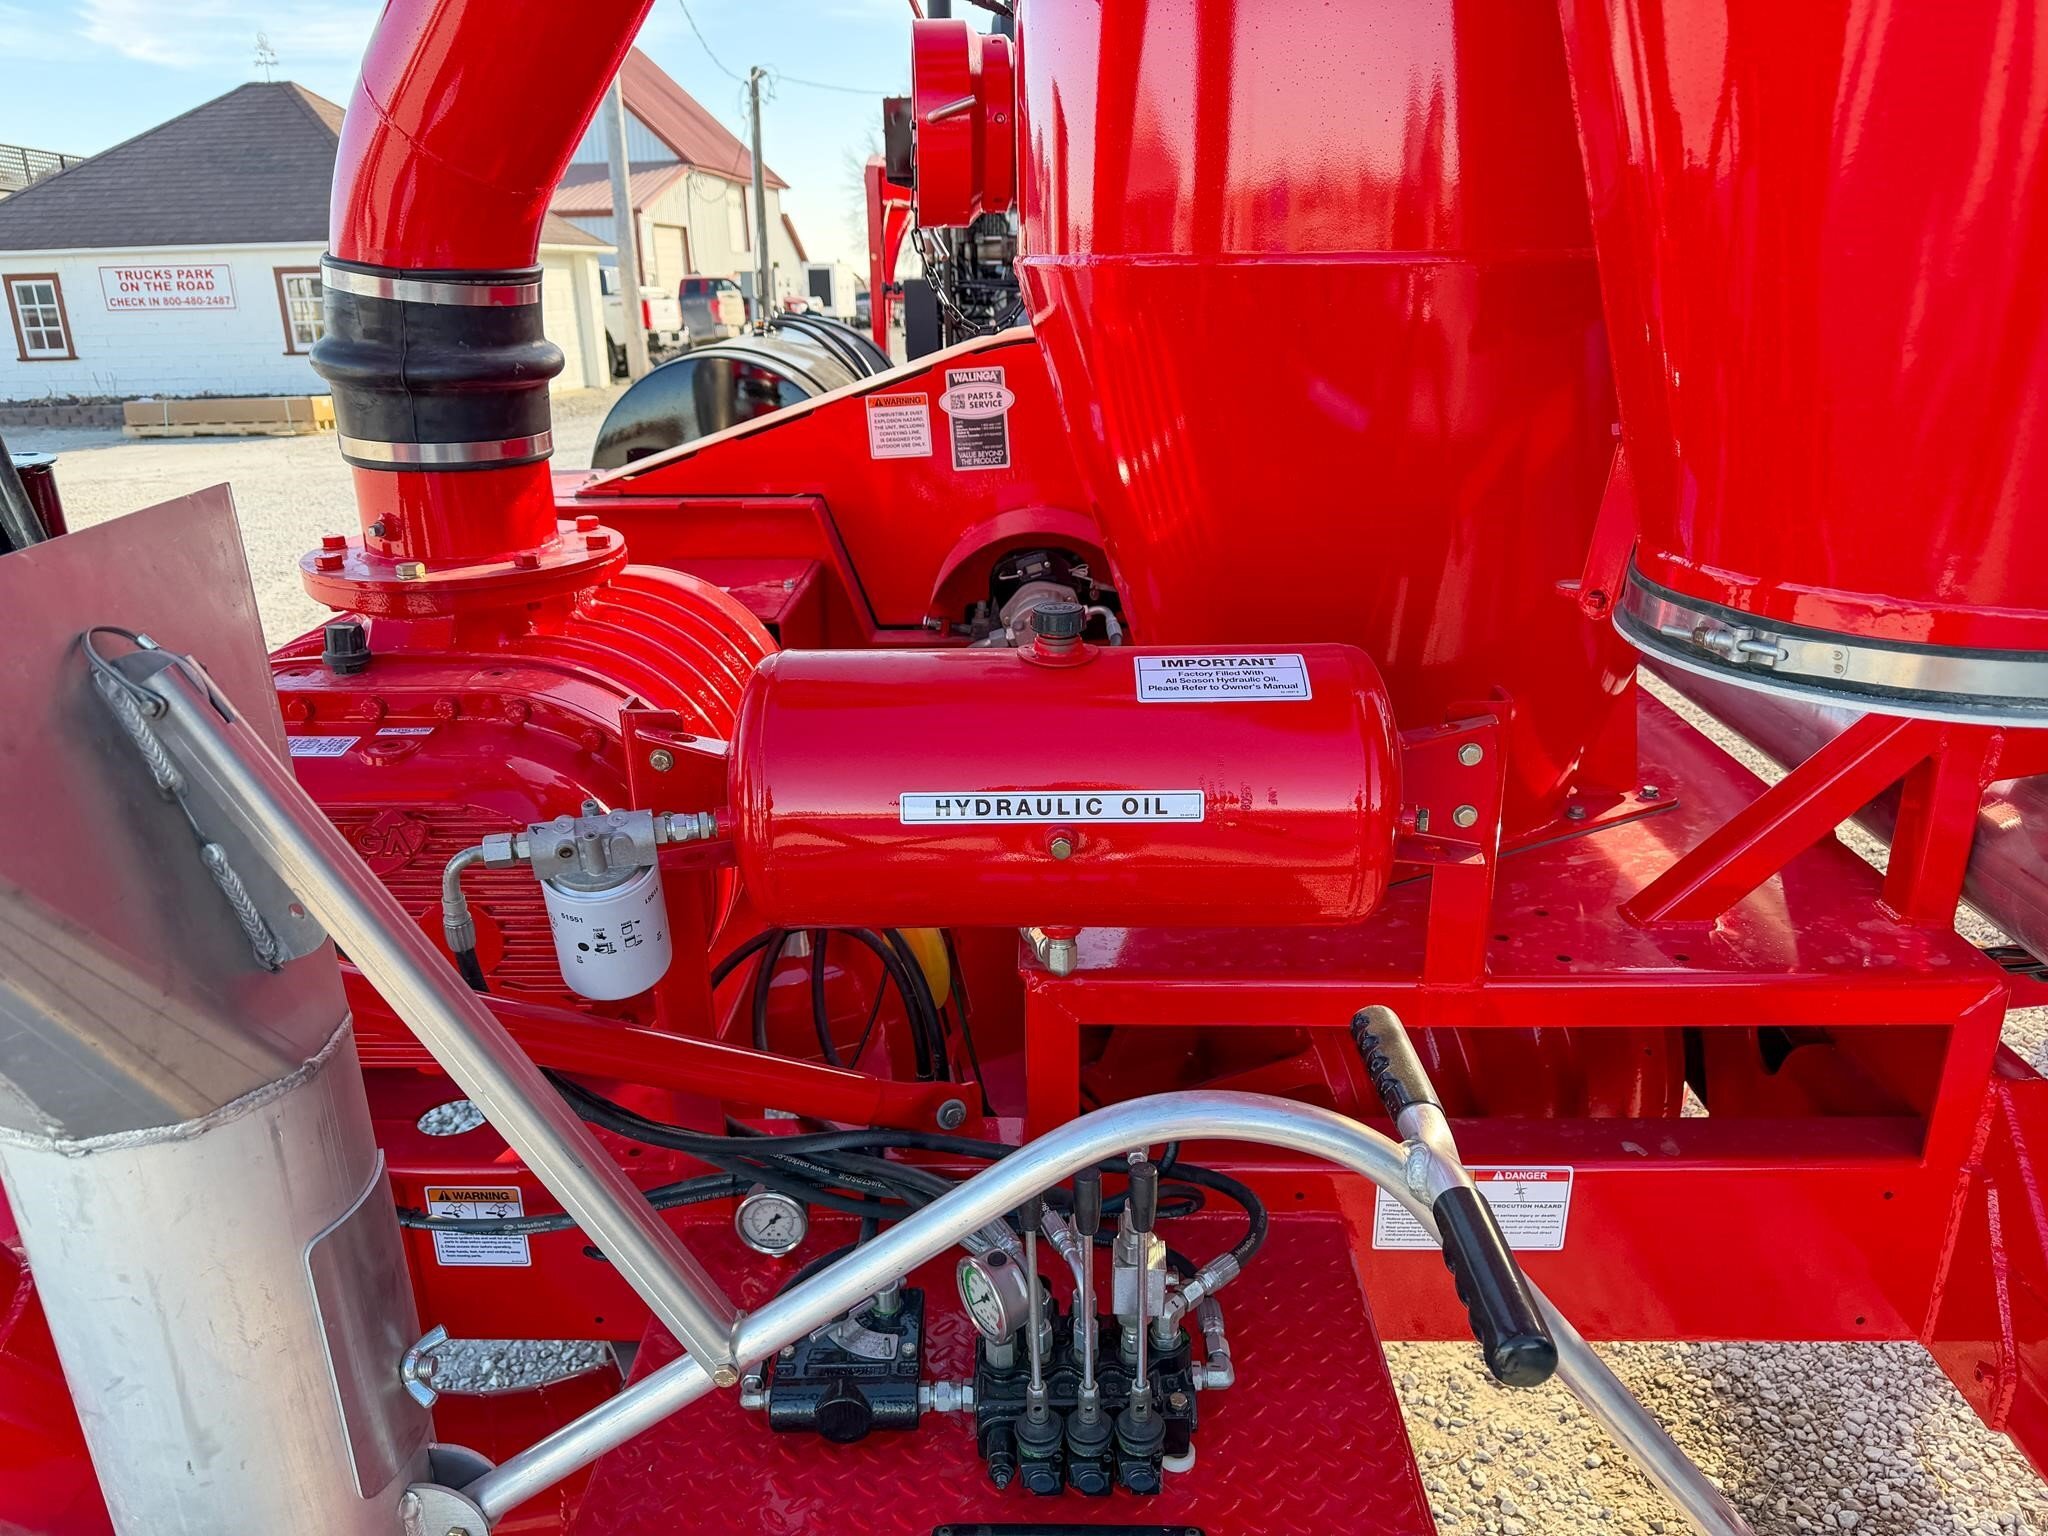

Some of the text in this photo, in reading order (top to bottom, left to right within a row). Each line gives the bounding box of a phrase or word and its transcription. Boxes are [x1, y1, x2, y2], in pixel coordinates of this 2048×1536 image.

[115, 268, 215, 281] TRUCKS PARK
[120, 280, 215, 292] ON THE ROAD
[109, 297, 145, 307] CHECK
[149, 296, 160, 306] IN
[952, 371, 997, 384] WALINGA
[967, 391, 1003, 400] PARTS &
[883, 396, 922, 406] WARNING
[969, 399, 1003, 409] SERVICE
[957, 449, 1004, 459] VALUE BEYOND
[973, 457, 1002, 465] PRODUCT
[1161, 657, 1277, 668] IMPORTANT
[1263, 682, 1299, 690] Manual
[935, 797, 1169, 817] HYDRAULIC OIL
[561, 912, 584, 923] 51551
[1505, 1172, 1548, 1180] DANGER
[452, 1191, 509, 1200] WARNING
